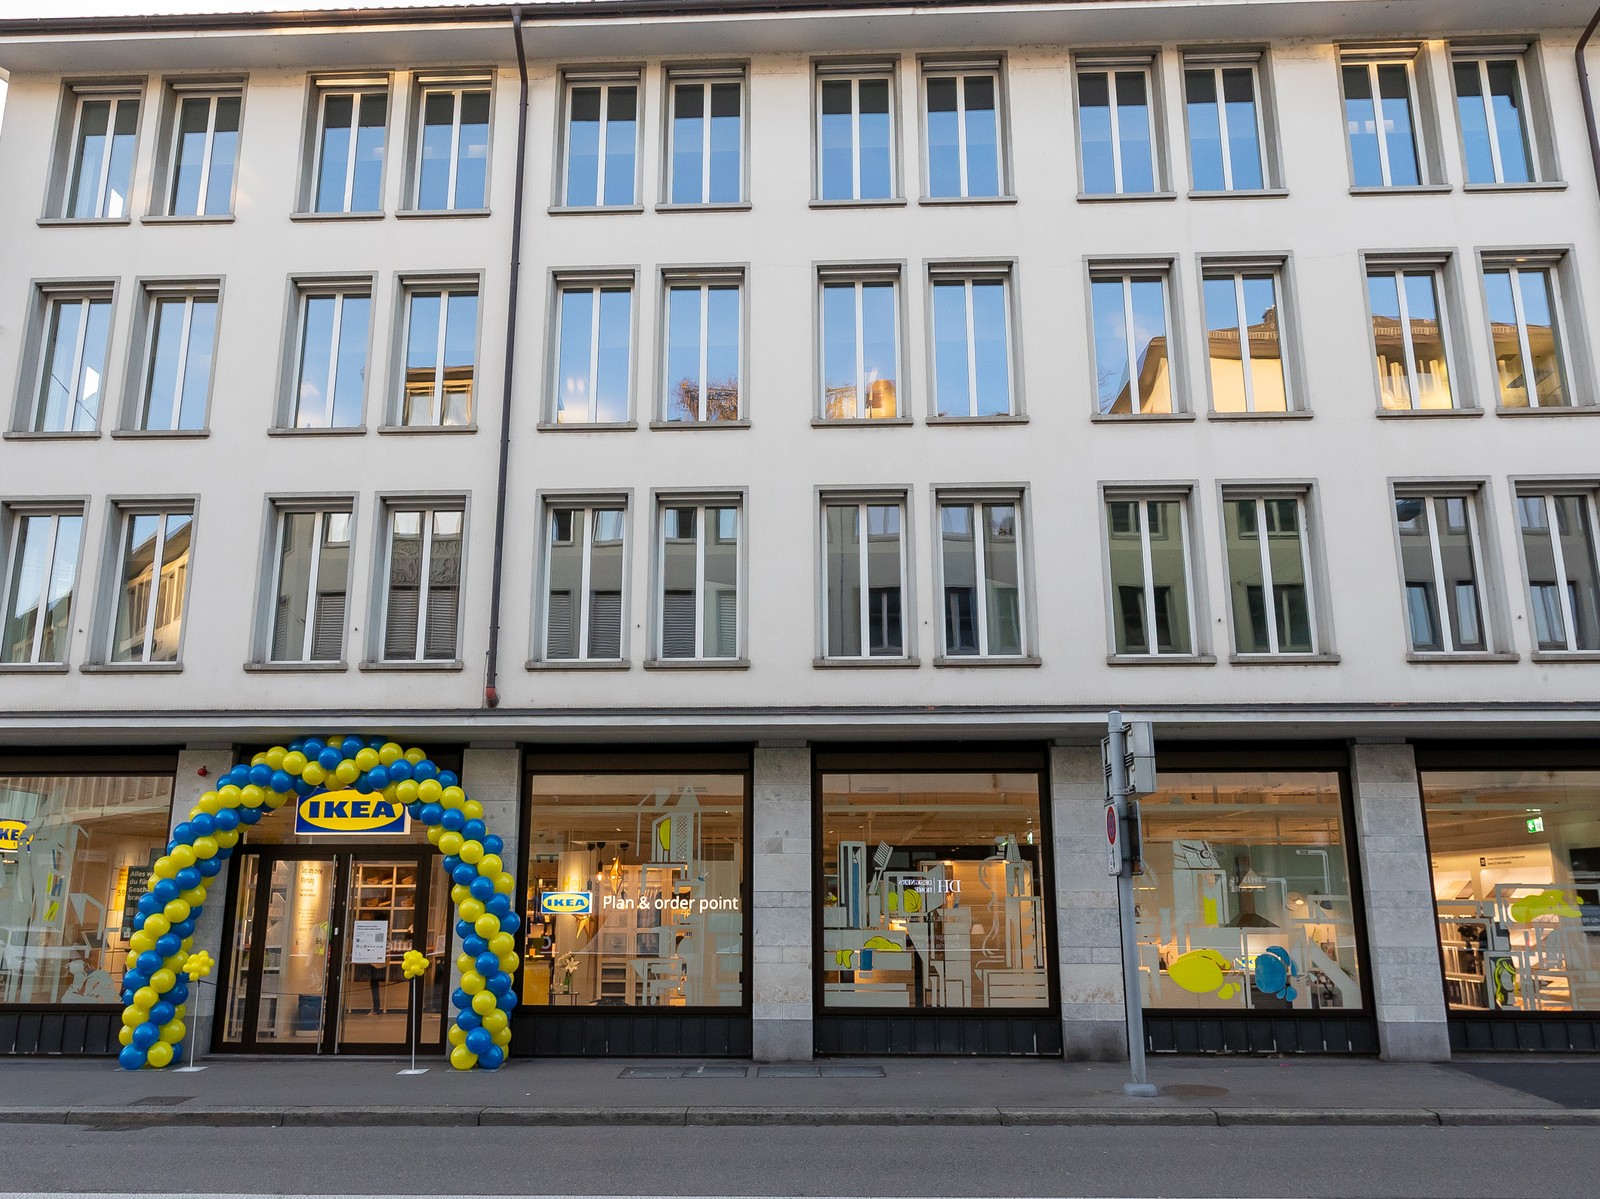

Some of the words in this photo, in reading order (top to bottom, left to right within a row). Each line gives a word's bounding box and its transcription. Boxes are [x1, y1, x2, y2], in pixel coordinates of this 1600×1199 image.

[308, 801, 396, 818] IKEA
[0, 828, 20, 841] KE
[547, 898, 586, 907] IKEA
[603, 896, 634, 910] Plan
[638, 896, 650, 910] &
[654, 896, 695, 910] order
[699, 896, 739, 913] point
